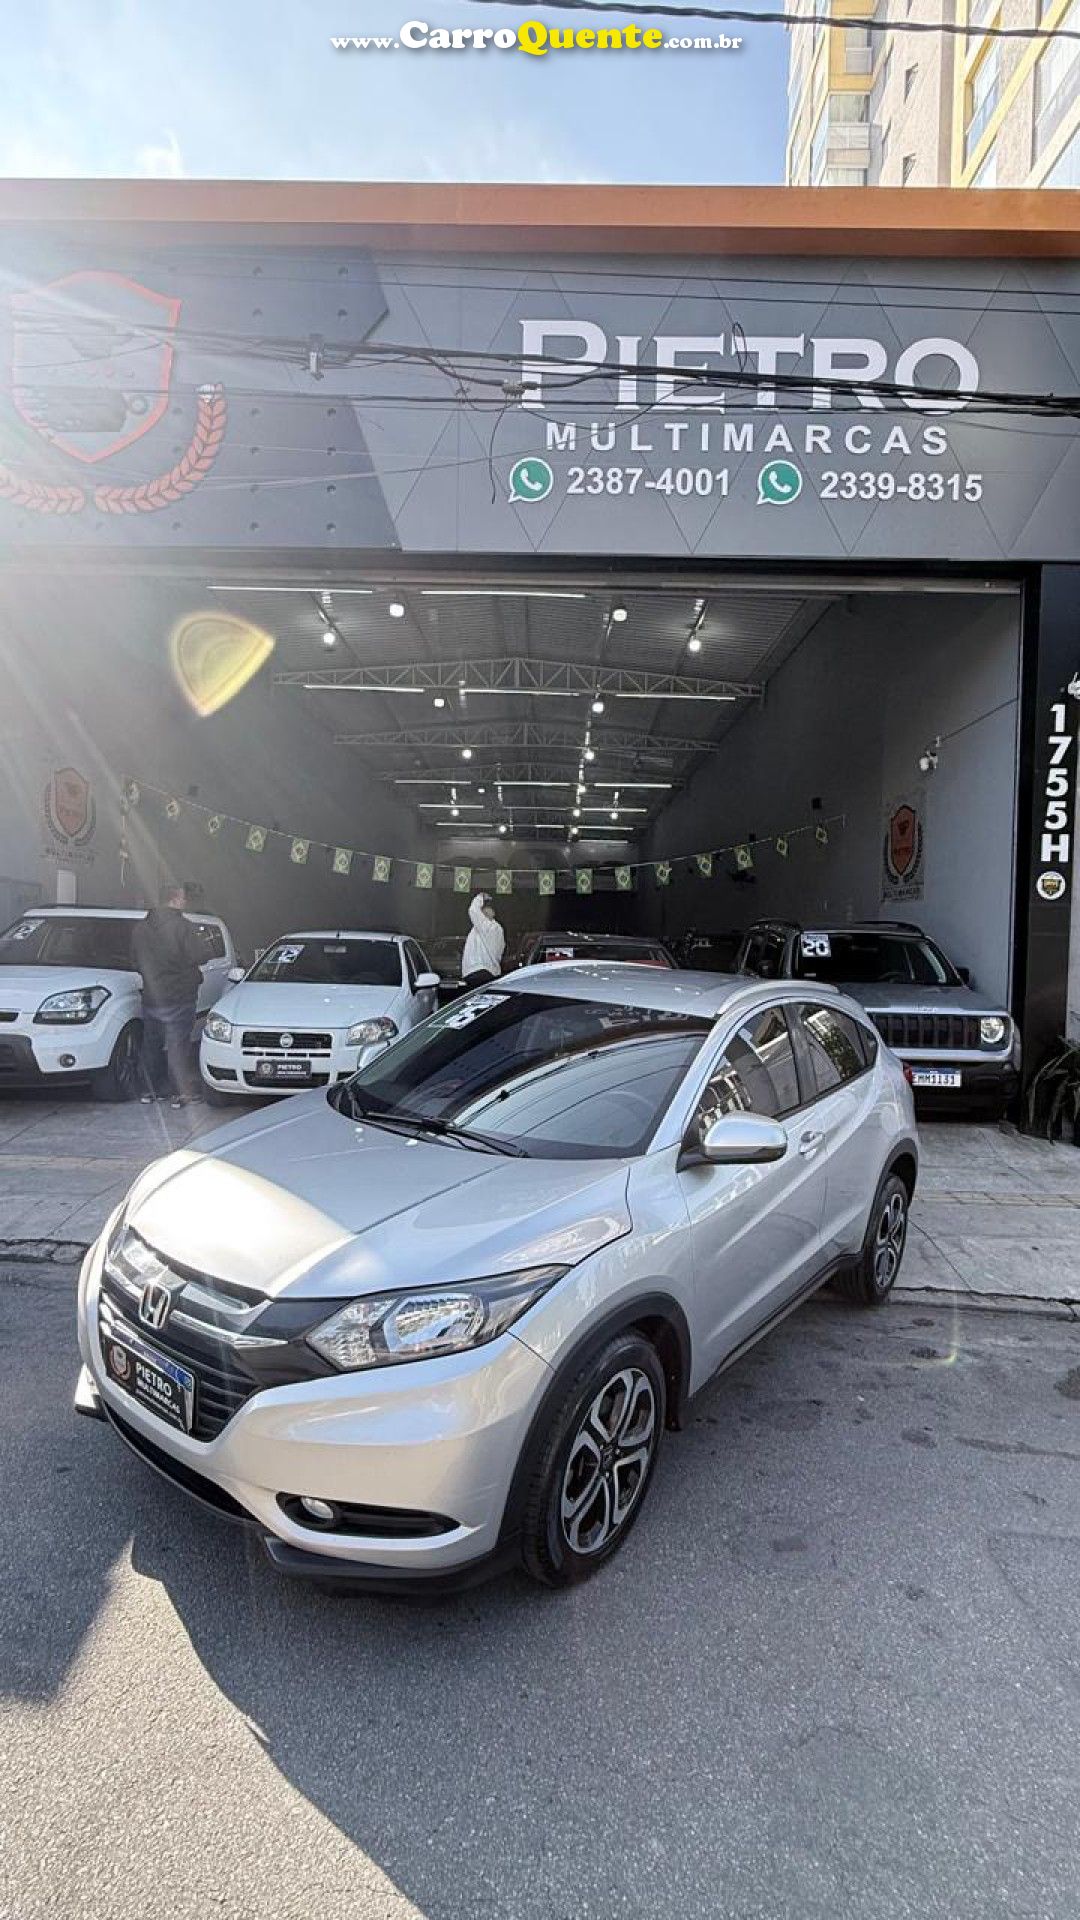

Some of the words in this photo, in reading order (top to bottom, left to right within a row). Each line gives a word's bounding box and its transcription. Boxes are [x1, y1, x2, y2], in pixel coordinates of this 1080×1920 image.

[518, 319, 980, 415] PIETRO
[546, 422, 948, 455] MULTIMARCAS
[566, 467, 730, 497] 2387-4001
[820, 471, 983, 502] 2339-8315
[1040, 704, 1073, 862] 1755H
[803, 940, 829, 956] 20
[135, 1361, 172, 1397] PIETRO
